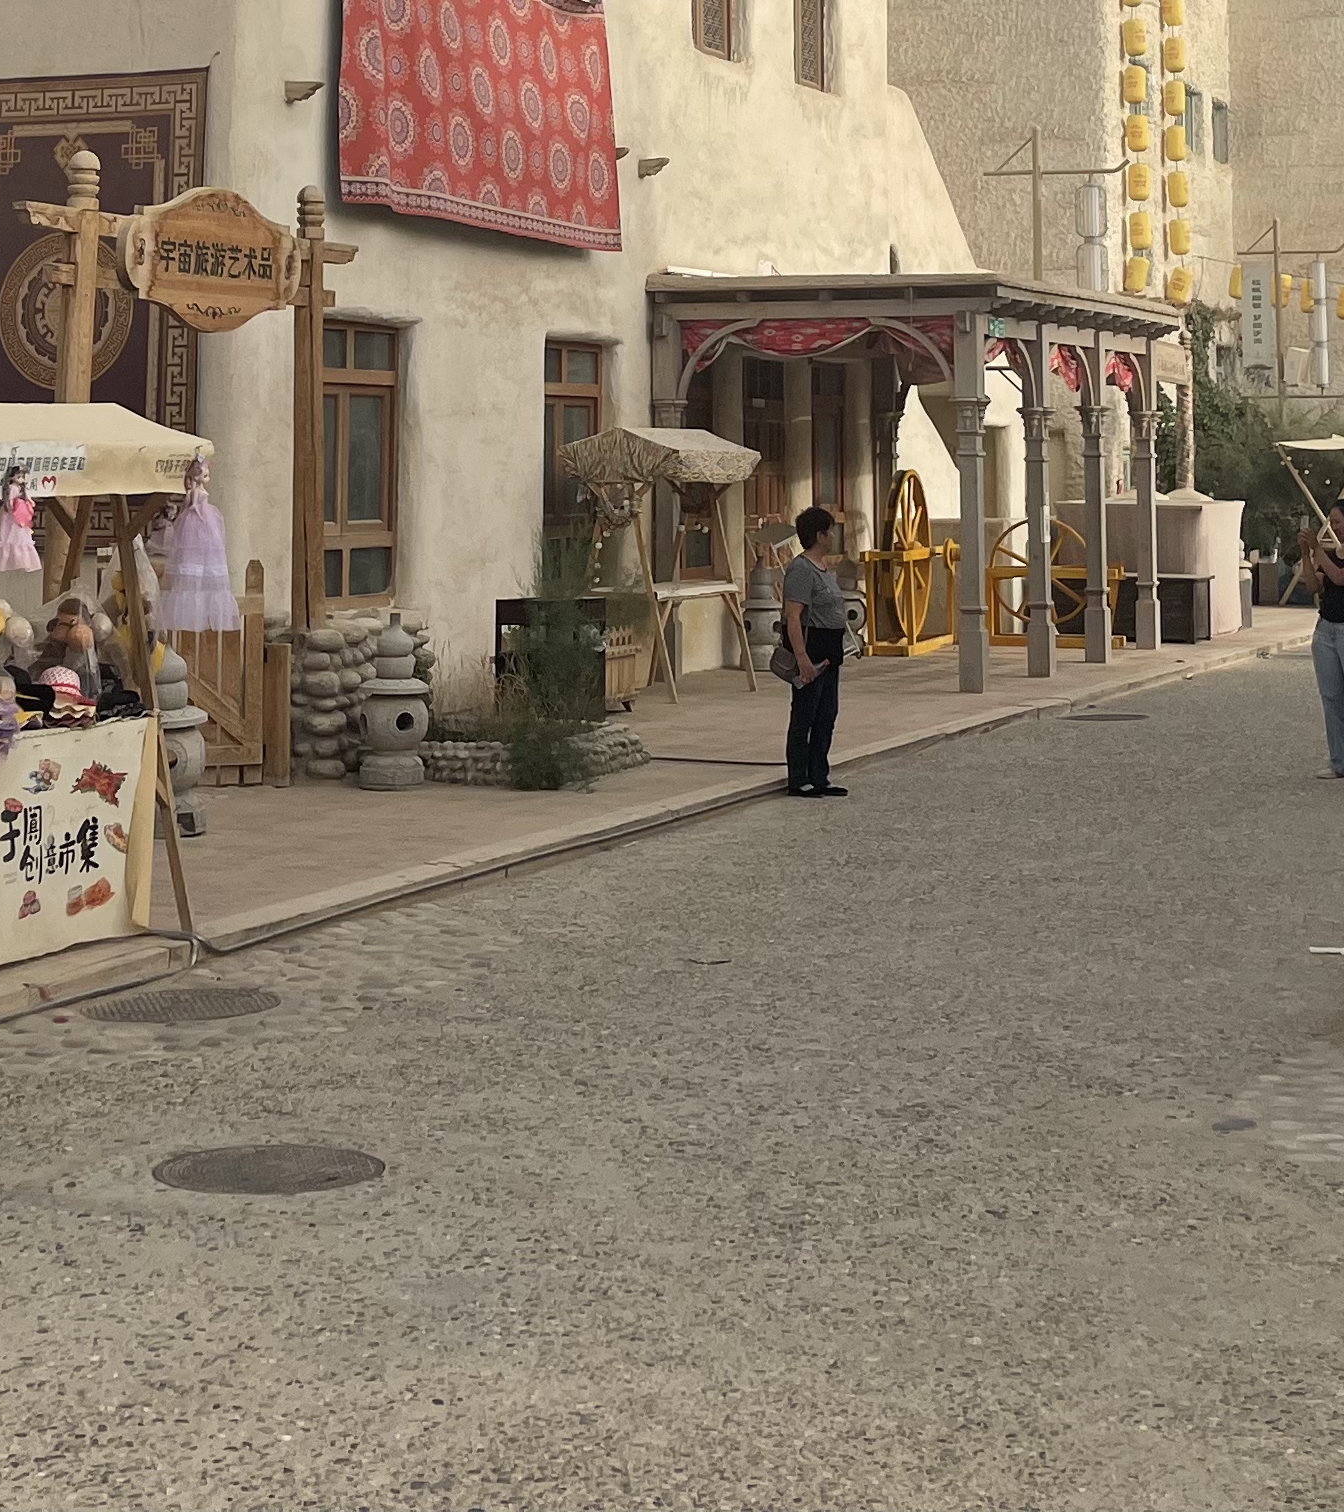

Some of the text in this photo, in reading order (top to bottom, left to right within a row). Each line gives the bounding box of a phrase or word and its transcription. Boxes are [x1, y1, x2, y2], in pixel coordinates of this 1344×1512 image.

[160, 237, 273, 280] 宇宙旅游艺术品
